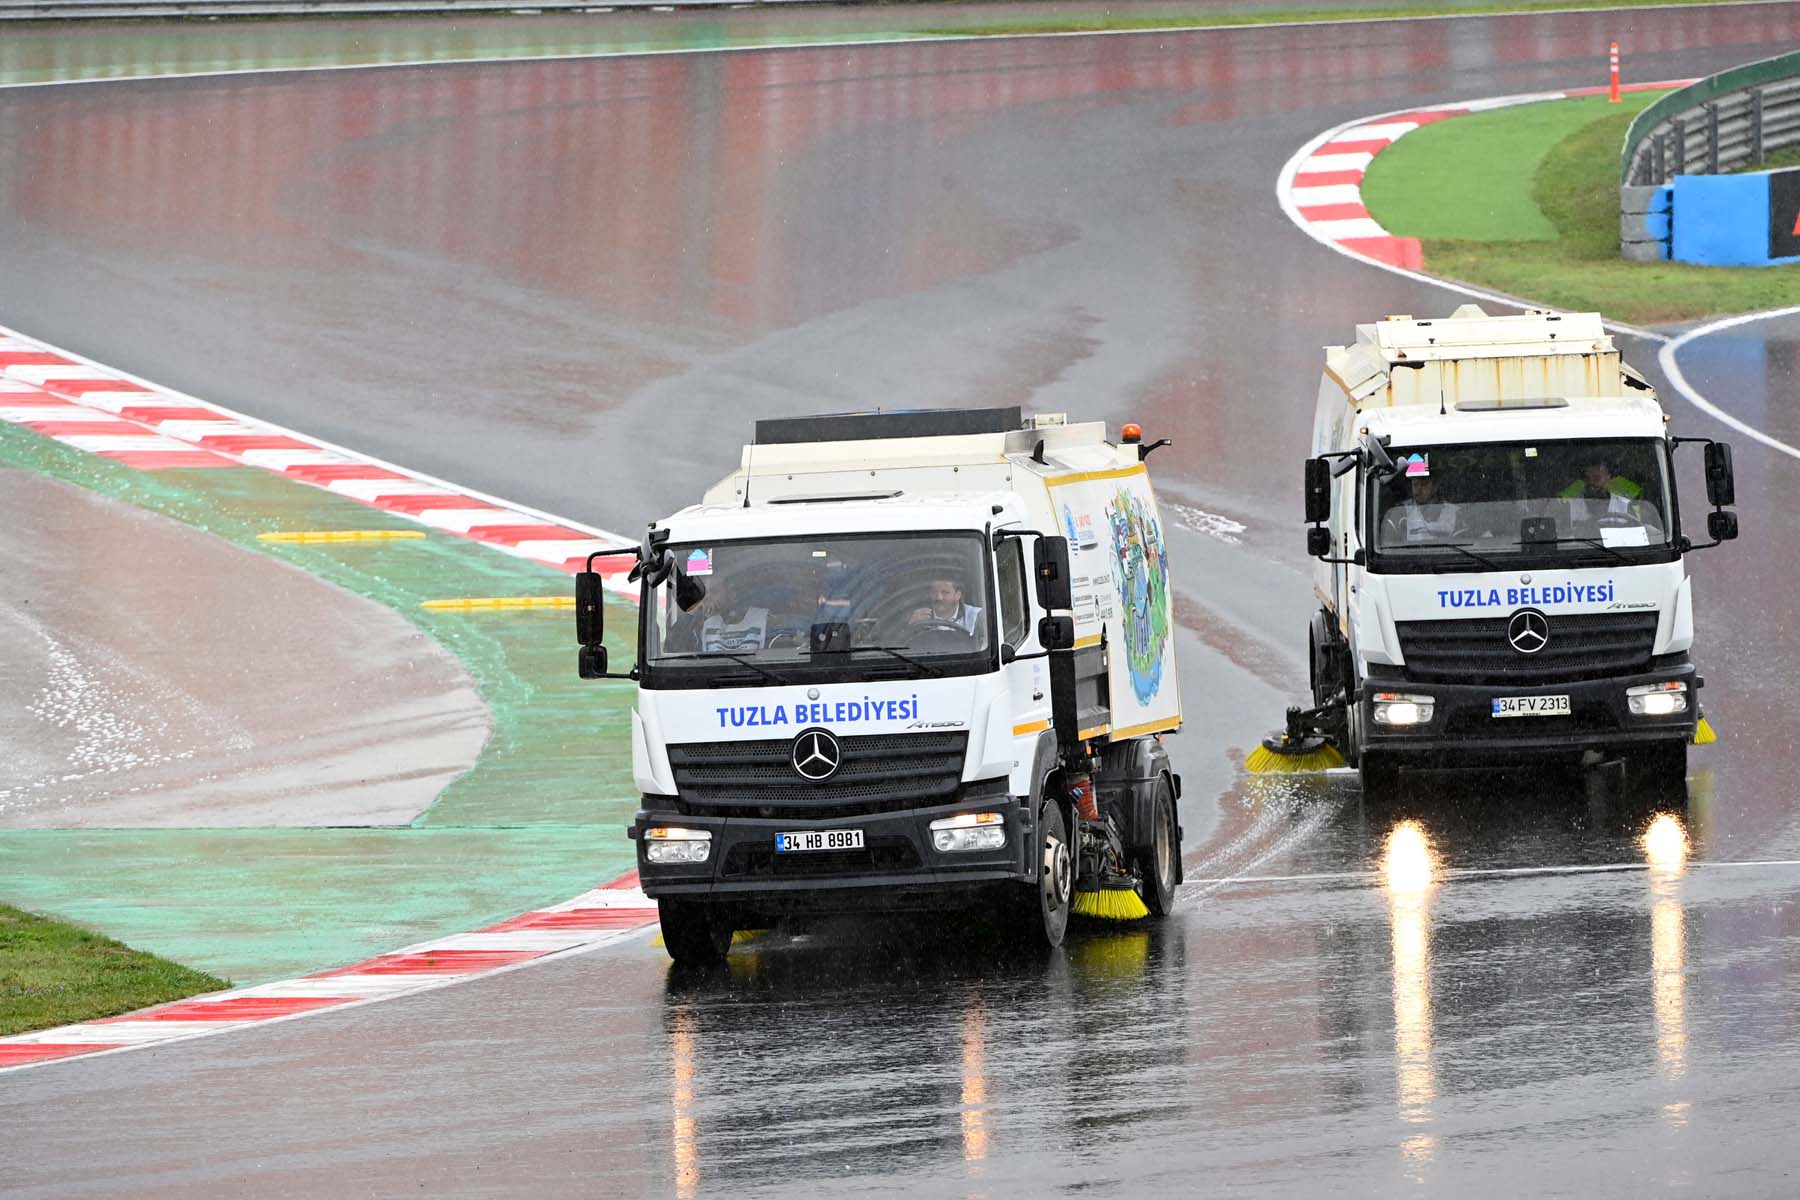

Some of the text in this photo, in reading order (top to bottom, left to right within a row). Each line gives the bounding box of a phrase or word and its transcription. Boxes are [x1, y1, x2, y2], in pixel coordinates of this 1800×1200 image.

[1438, 580, 1614, 608] TUZLA BELEDİYESİ
[716, 694, 918, 728] TUZLA BELEDİYESİ
[1501, 699, 1515, 712] 34
[1518, 698, 1536, 711] FV
[1540, 697, 1568, 710] 2313
[784, 831, 861, 850] 34 HB 8981
